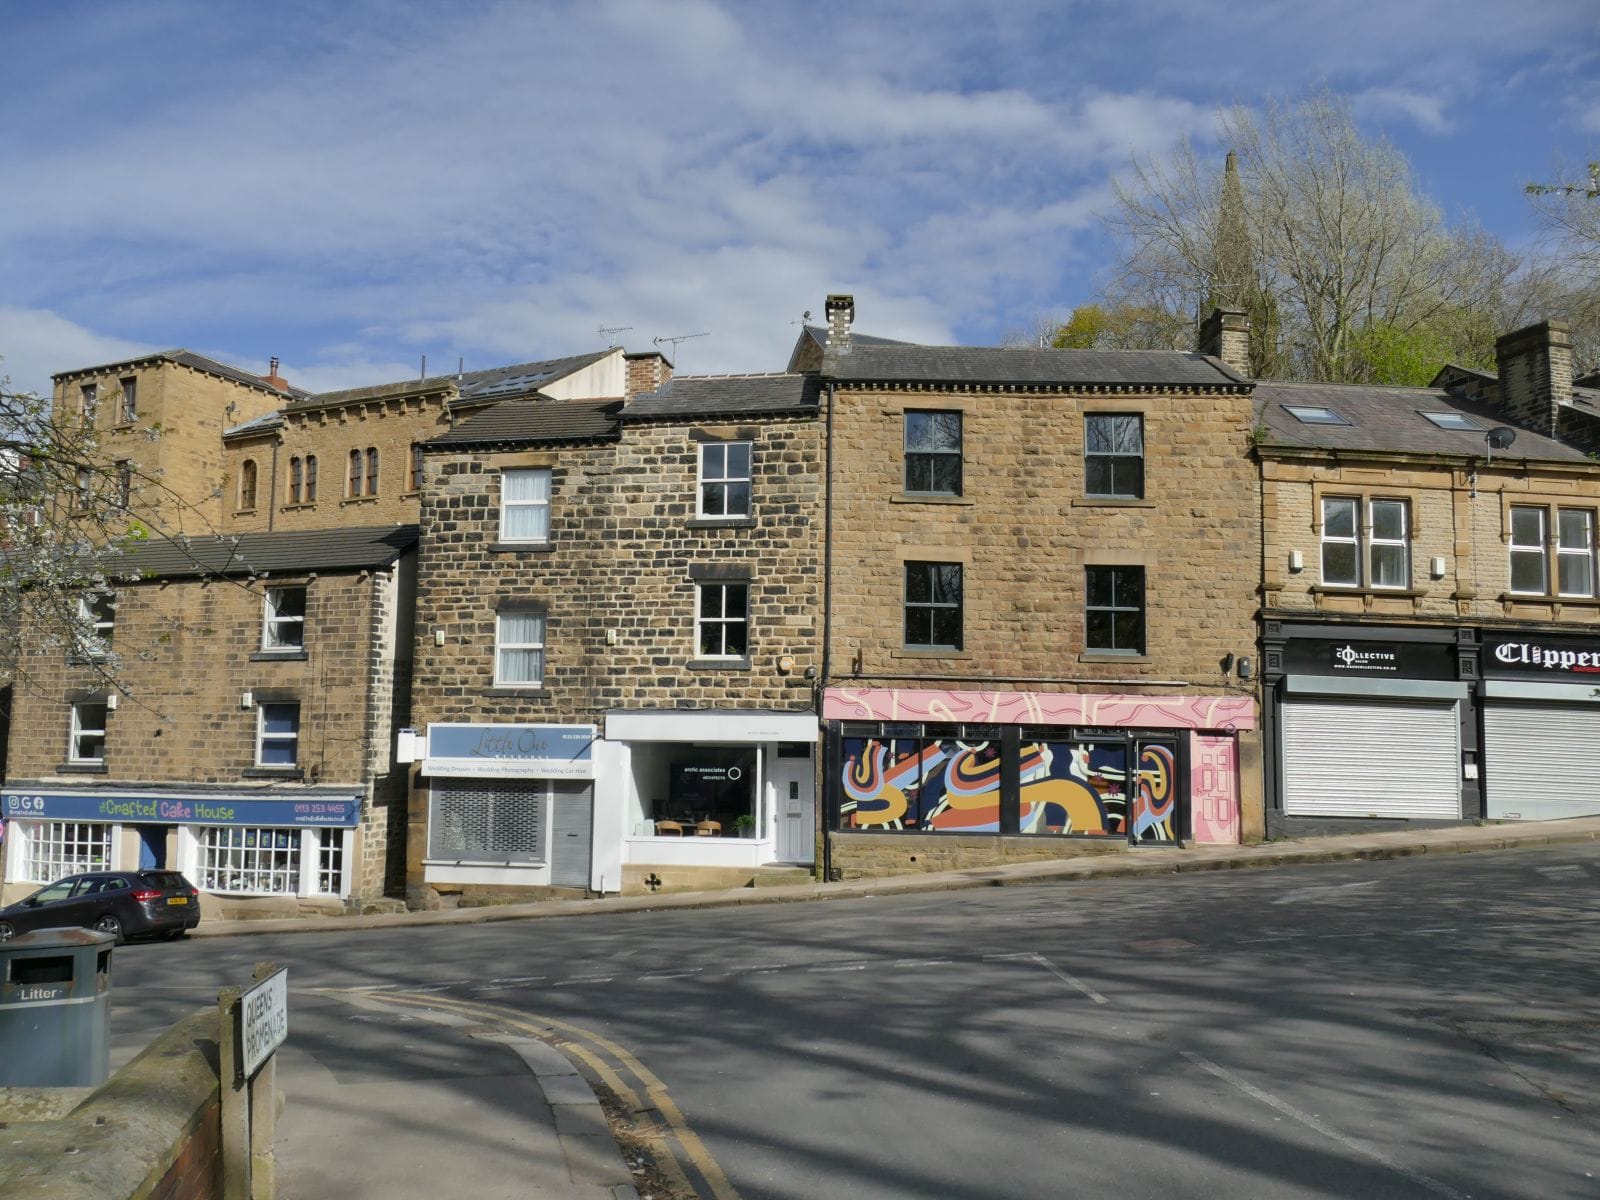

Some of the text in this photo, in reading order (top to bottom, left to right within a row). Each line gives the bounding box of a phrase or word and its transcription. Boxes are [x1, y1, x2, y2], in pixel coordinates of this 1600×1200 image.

[541, 767, 564, 775] Wedding
[106, 799, 157, 818] Crafted
[160, 801, 191, 818] Cake
[194, 803, 235, 819] House
[21, 988, 58, 1000] Litter
[247, 987, 272, 1028] QUEENS
[247, 1007, 285, 1064] PROMENADE
